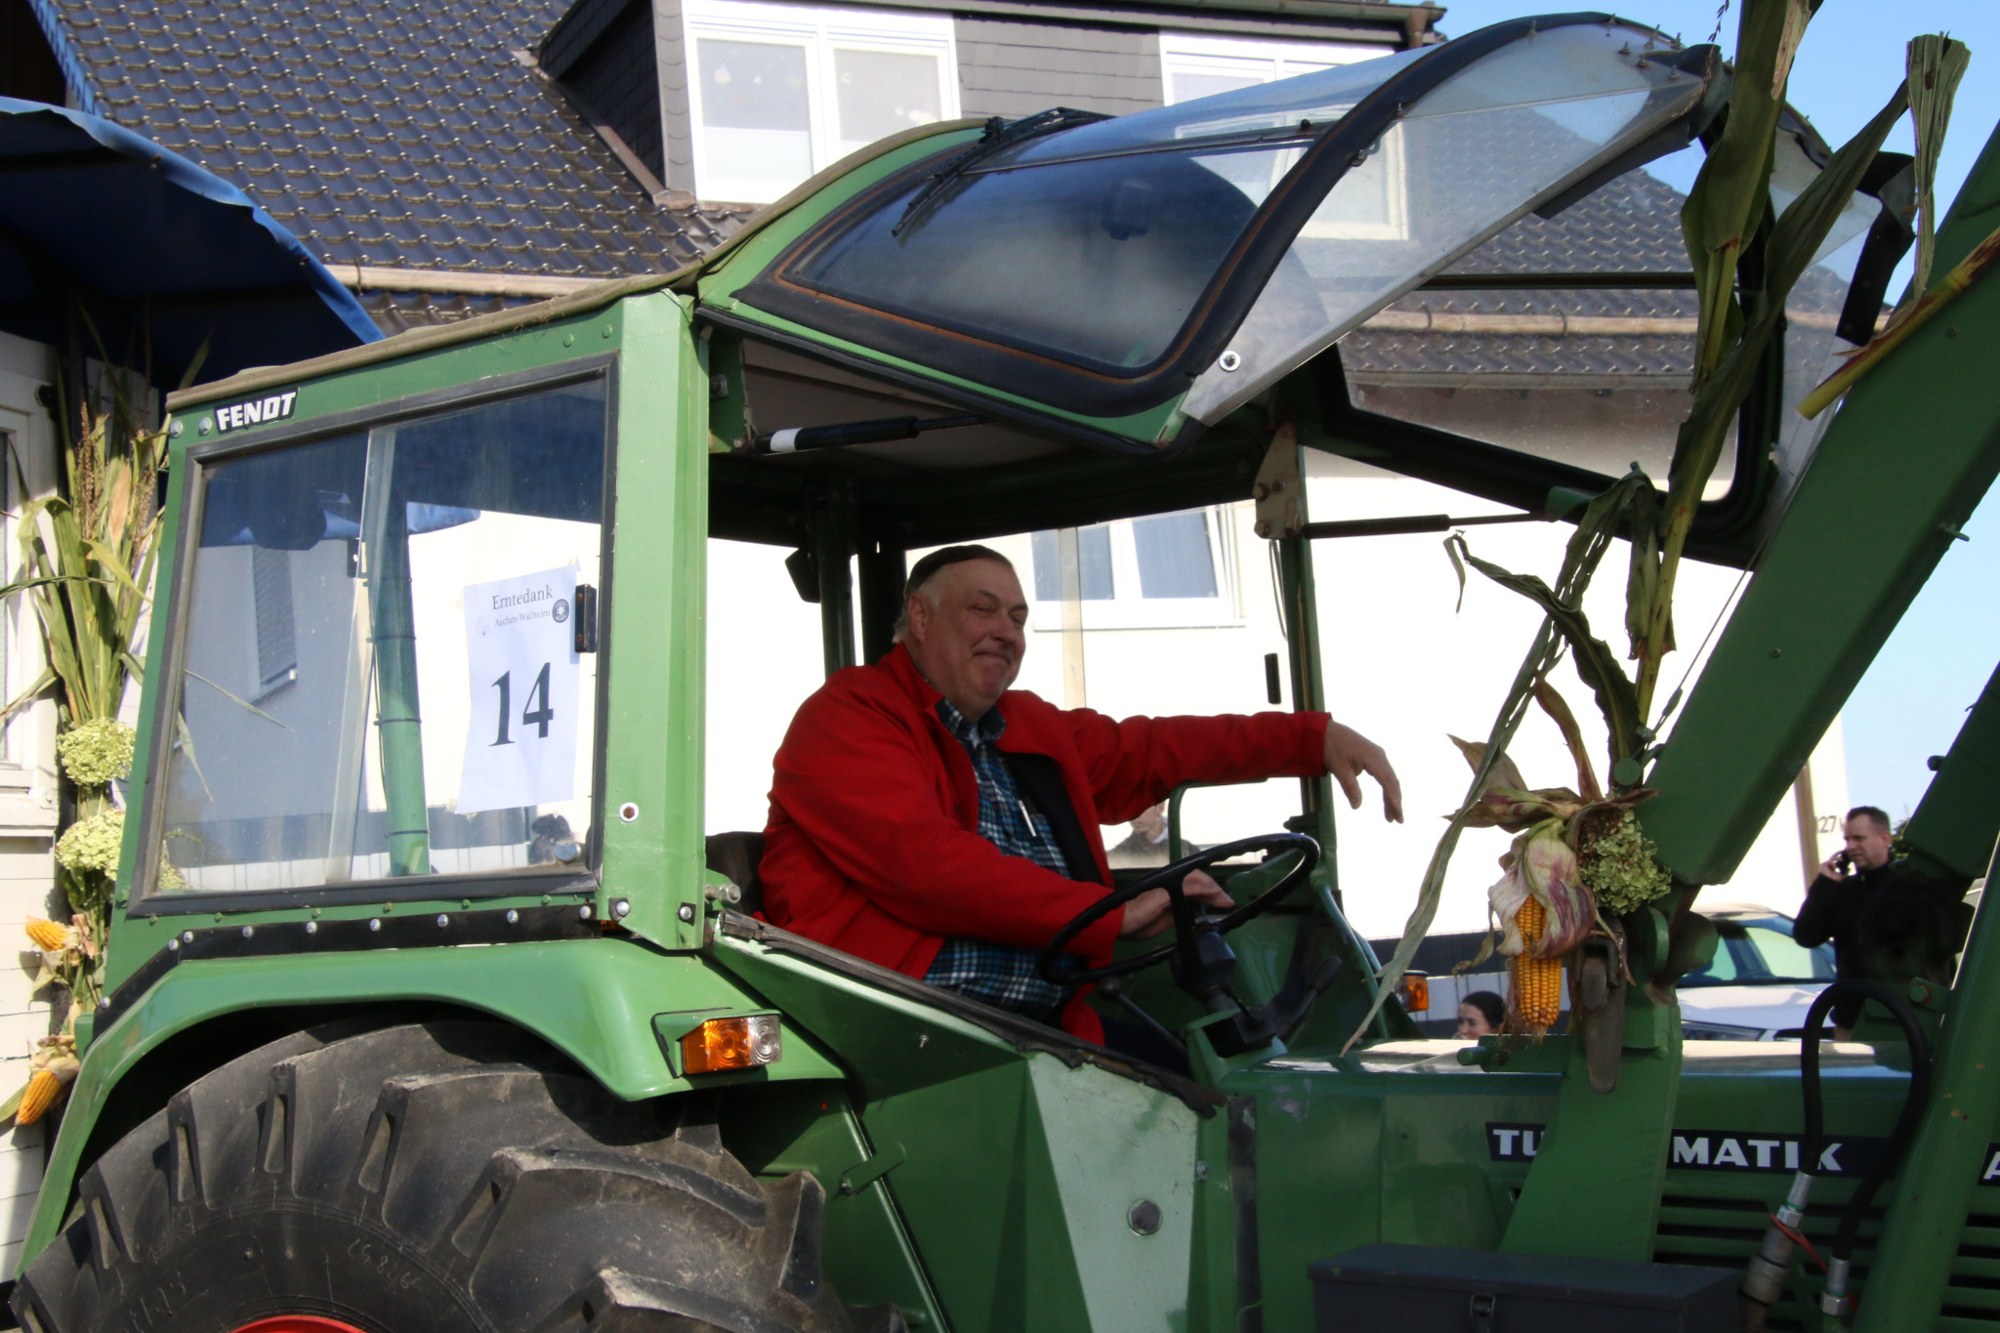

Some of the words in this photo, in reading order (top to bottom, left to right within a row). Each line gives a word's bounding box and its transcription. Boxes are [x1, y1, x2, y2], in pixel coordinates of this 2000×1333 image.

[216, 391, 297, 431] FENDT
[492, 585, 554, 610] Erntedank
[488, 661, 554, 747] 14
[1492, 1128, 1843, 1172] TUMATIK
